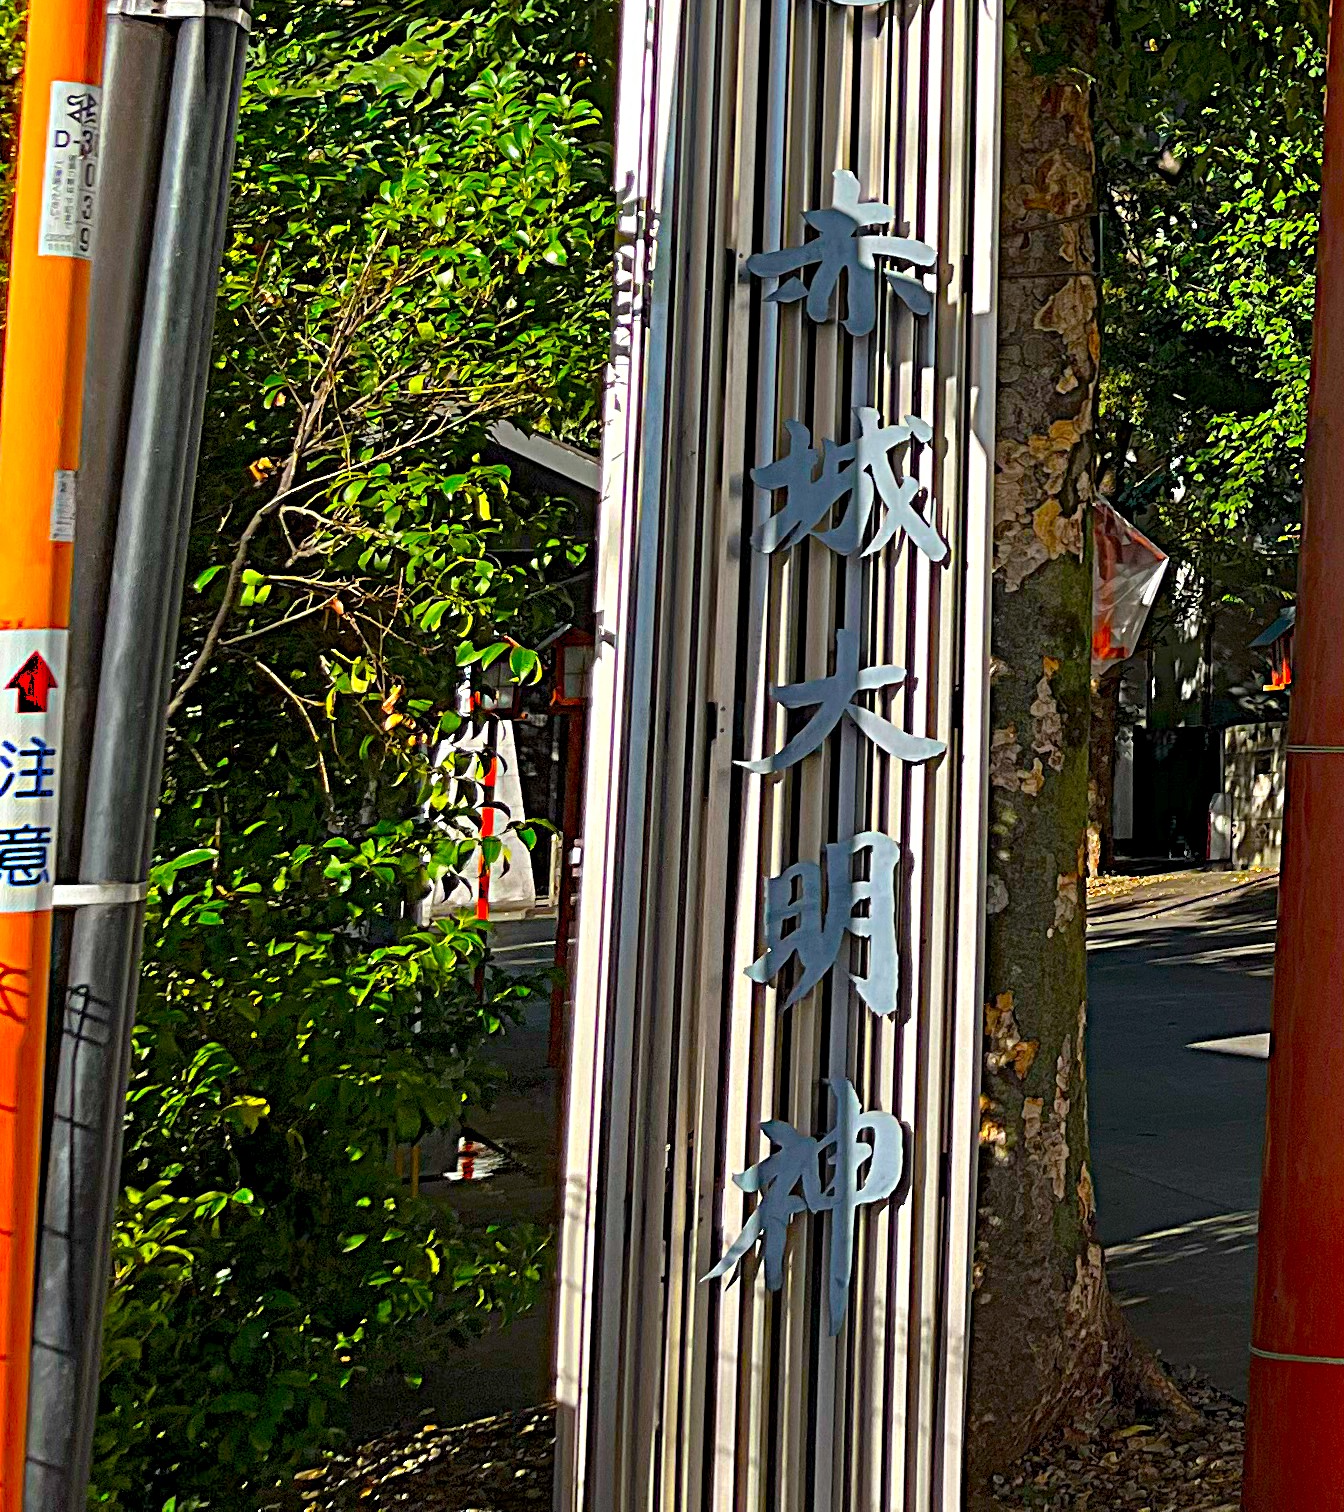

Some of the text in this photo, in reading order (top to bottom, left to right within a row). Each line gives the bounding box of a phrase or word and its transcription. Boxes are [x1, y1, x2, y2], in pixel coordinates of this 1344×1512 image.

[0, 737, 56, 886] 注意
[700, 169, 949, 1337] 赤城大明神
